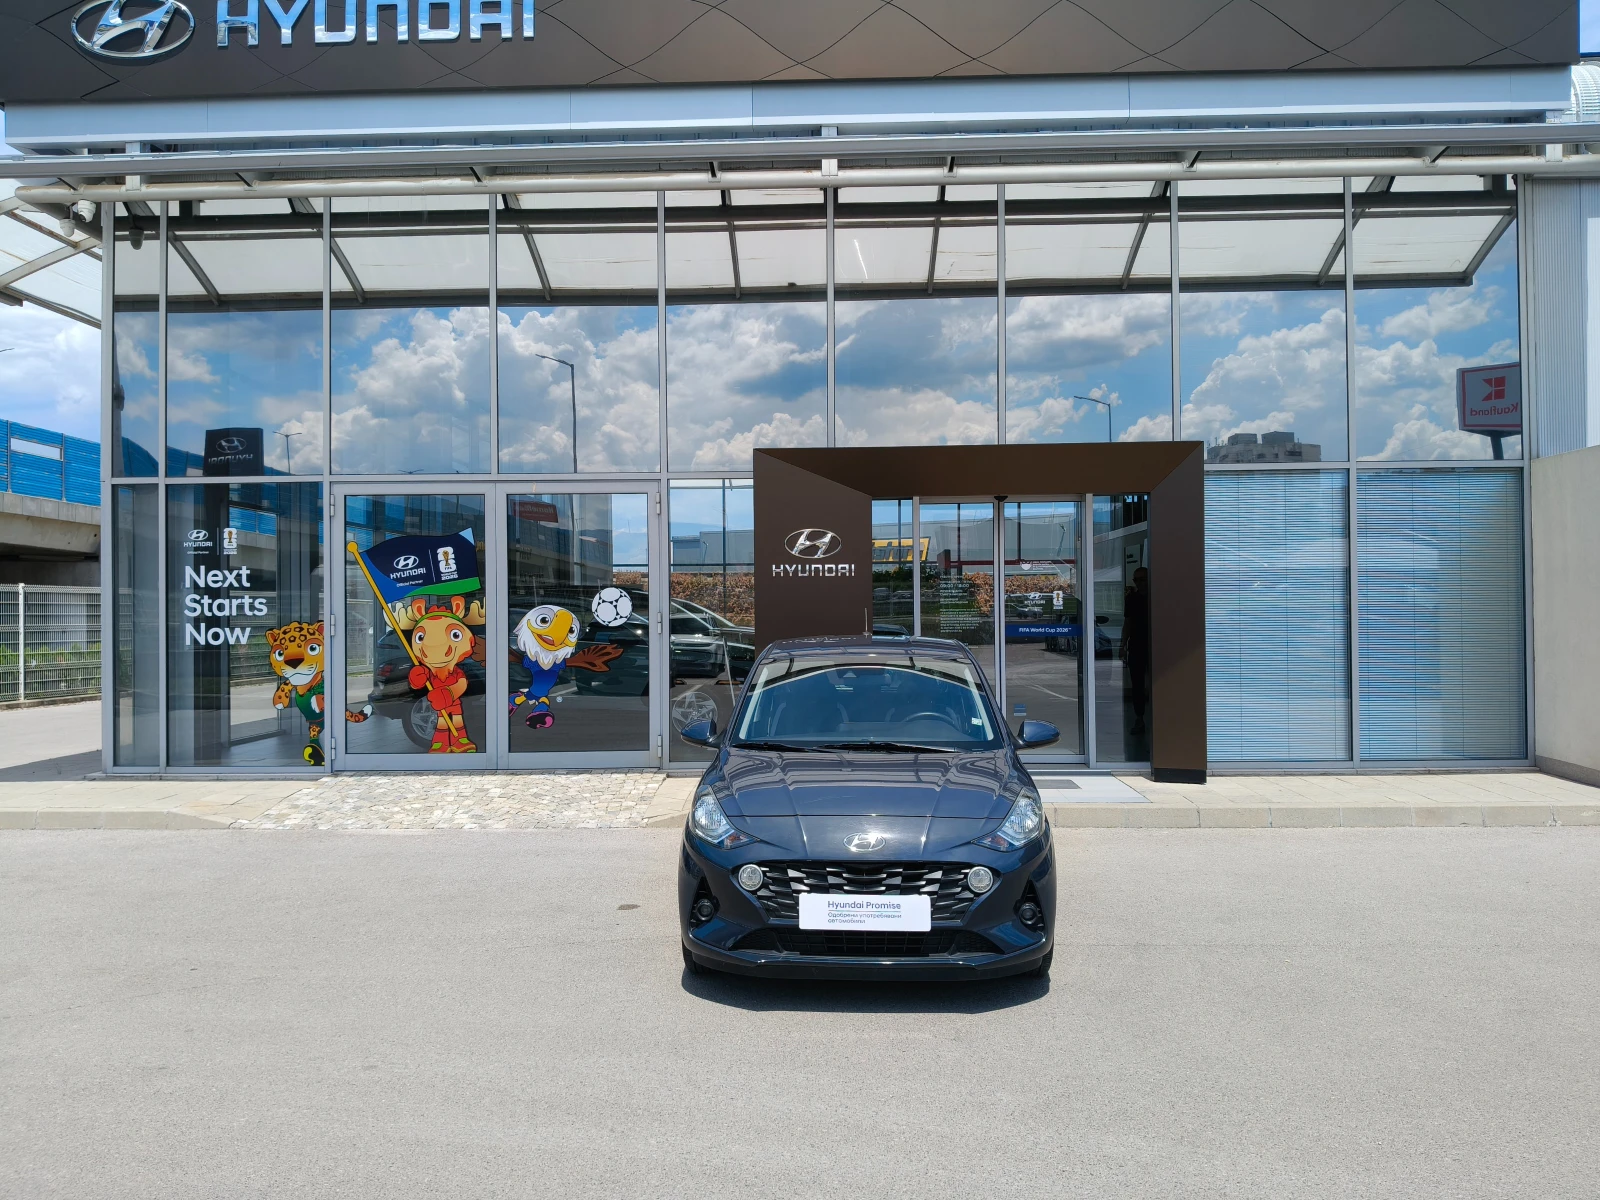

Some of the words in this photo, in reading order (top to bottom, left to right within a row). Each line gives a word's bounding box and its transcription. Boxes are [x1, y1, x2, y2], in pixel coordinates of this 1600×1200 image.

[216, 0, 535, 47] HYUNDAI
[185, 565, 251, 588] Next
[390, 568, 426, 579] HYUNDAI
[772, 564, 855, 577] HYUNDAI
[184, 593, 268, 617] Starts
[185, 622, 251, 645] Now
[827, 900, 864, 909] Hyundai
[866, 901, 901, 909] Promise
